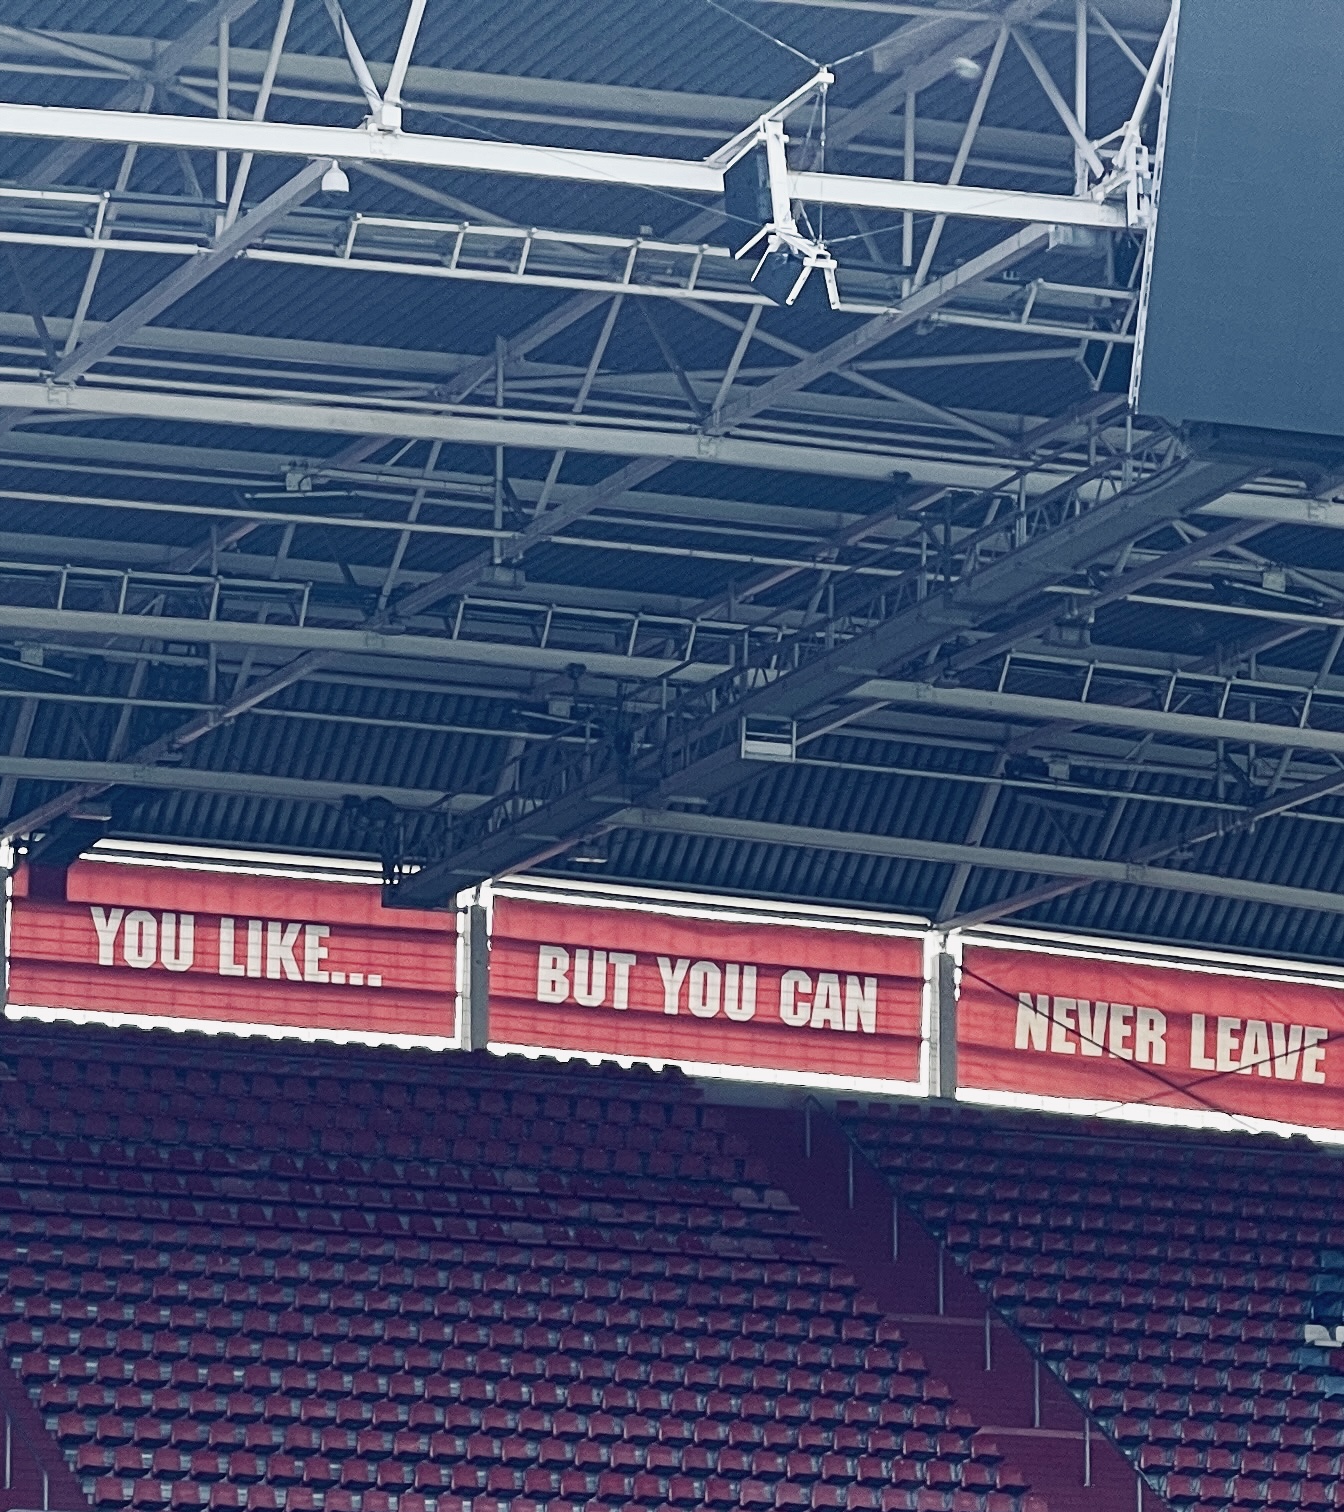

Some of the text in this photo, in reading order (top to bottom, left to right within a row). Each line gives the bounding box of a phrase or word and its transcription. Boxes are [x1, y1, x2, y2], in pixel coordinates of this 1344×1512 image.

[90, 906, 382, 987] YOU LIKE...
[537, 944, 878, 1034] BUT YOU CAN
[1014, 992, 1329, 1084] NEVER LEAVE
